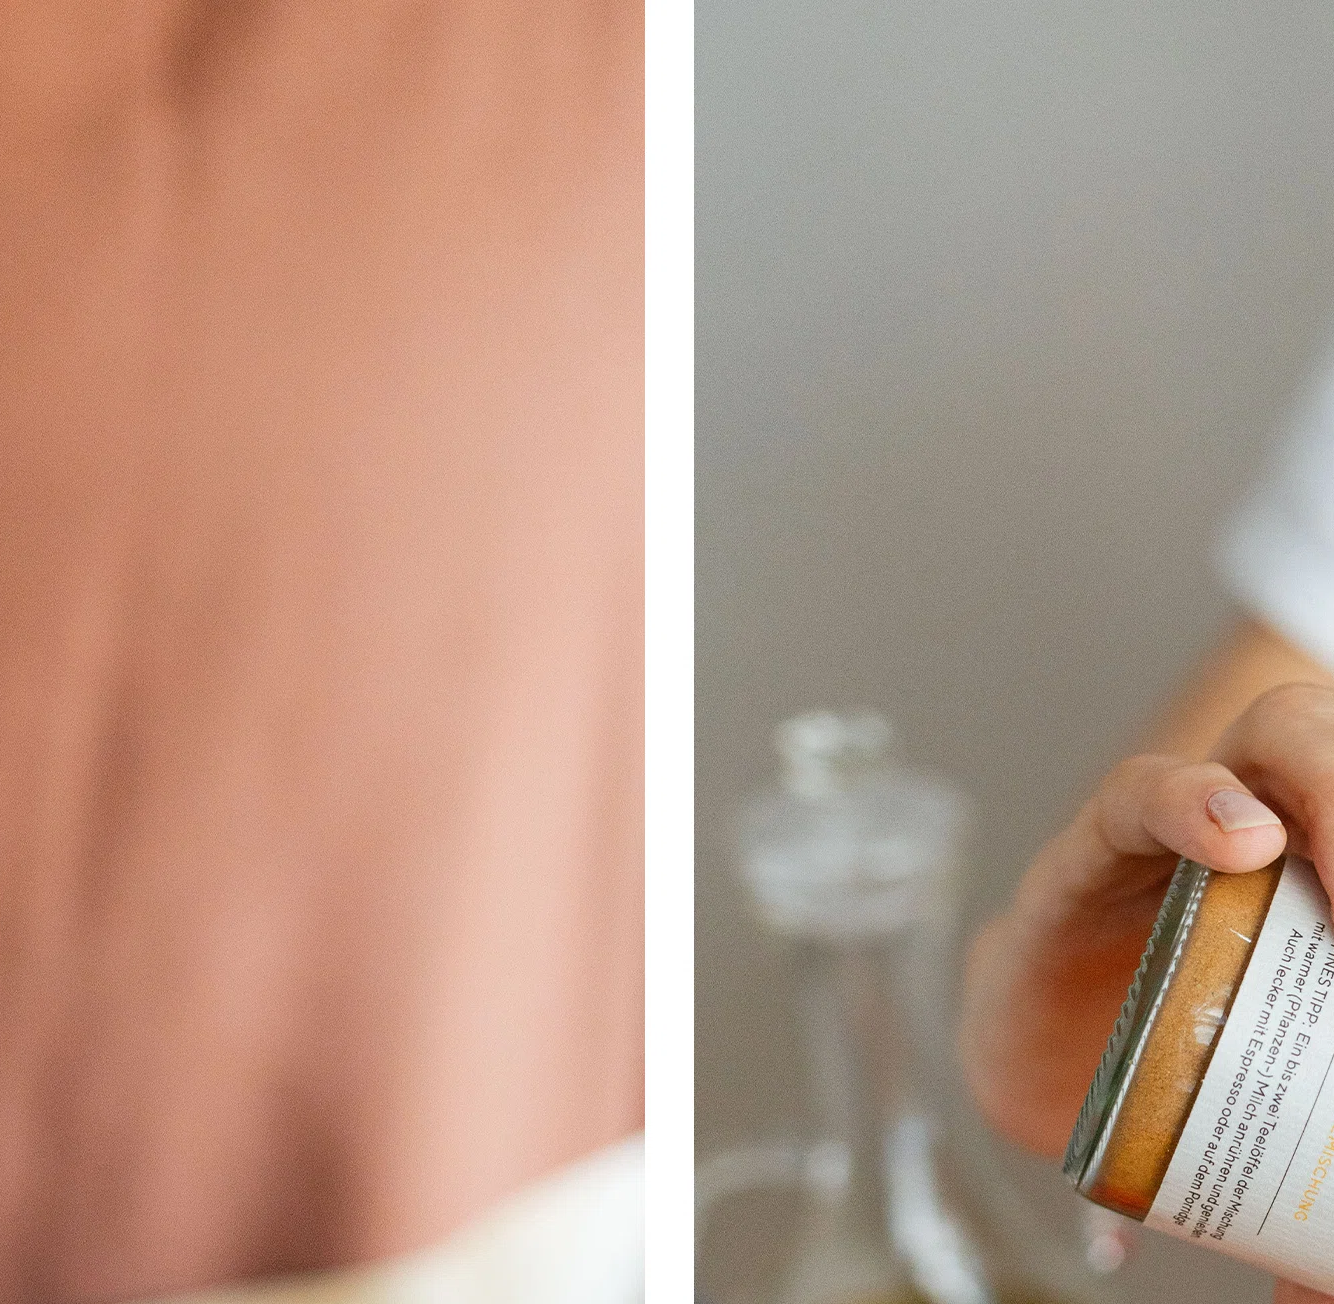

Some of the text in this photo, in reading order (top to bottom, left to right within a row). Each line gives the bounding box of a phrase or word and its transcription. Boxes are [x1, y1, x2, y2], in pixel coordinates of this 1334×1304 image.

[1312, 922, 1327, 942] mit
[1293, 942, 1319, 993] warmer
[1302, 990, 1328, 1028] TIPP:
[1256, 993, 1303, 1078] (Pflanzen-)
[1290, 1032, 1311, 1057] Ein
[1172, 928, 1304, 1226] Auch lecker mit Espresso oder auf dem Porridge
[1281, 1059, 1301, 1082] bis
[1242, 1080, 1270, 1121] Milch
[1266, 1083, 1288, 1119] zwei
[1216, 1122, 1249, 1183] anrühren
[1241, 1121, 1277, 1180] Teelöffel
[1206, 1183, 1224, 1207] und
[1232, 1179, 1250, 1201] der
[1209, 1199, 1242, 1241] Mischung
